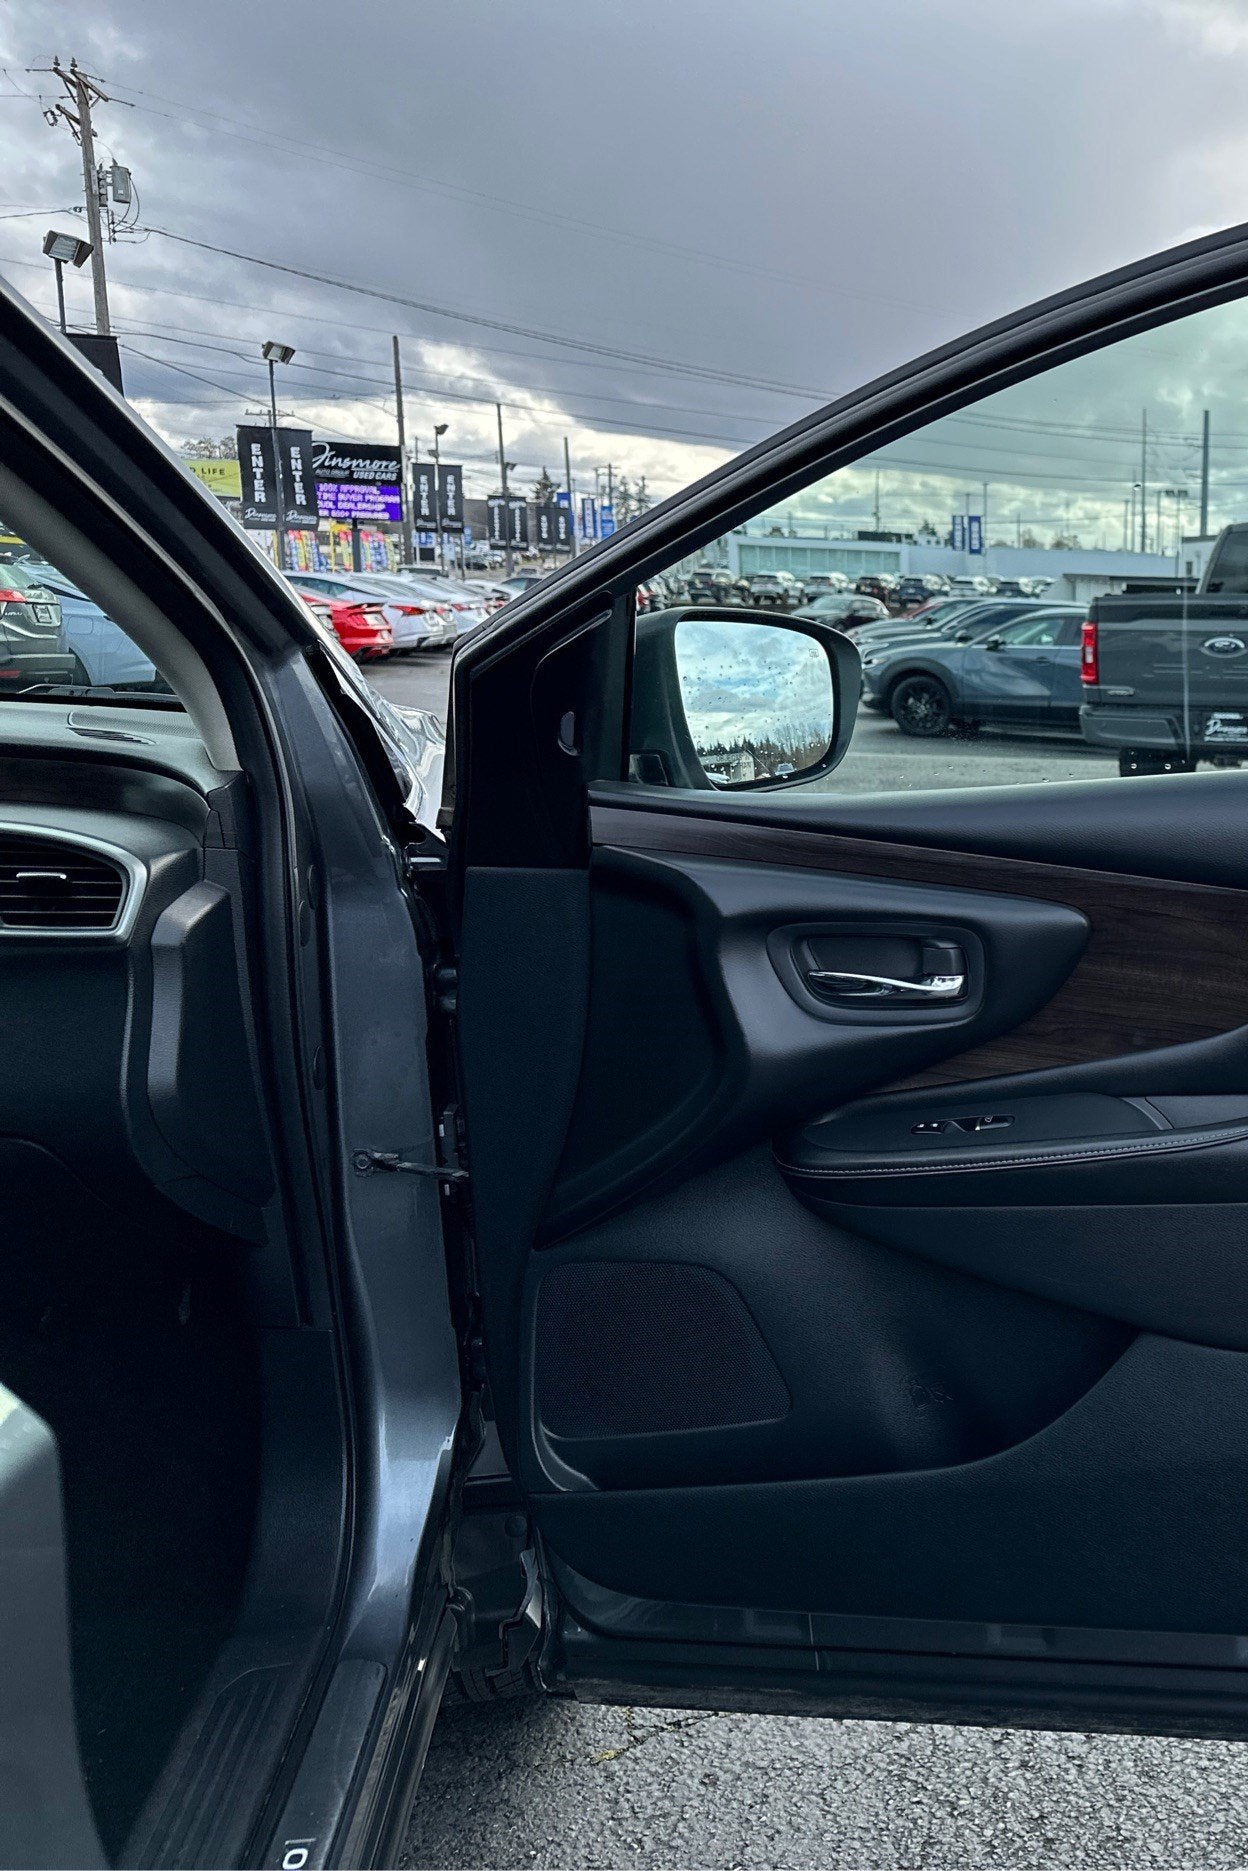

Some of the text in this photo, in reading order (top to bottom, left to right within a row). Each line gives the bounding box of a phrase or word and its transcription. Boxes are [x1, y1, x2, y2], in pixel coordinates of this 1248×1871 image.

[201, 467, 225, 475] LIFE
[250, 443, 266, 502] ENTER
[290, 446, 307, 505] ENTER
[352, 471, 397, 480] USED CARS
